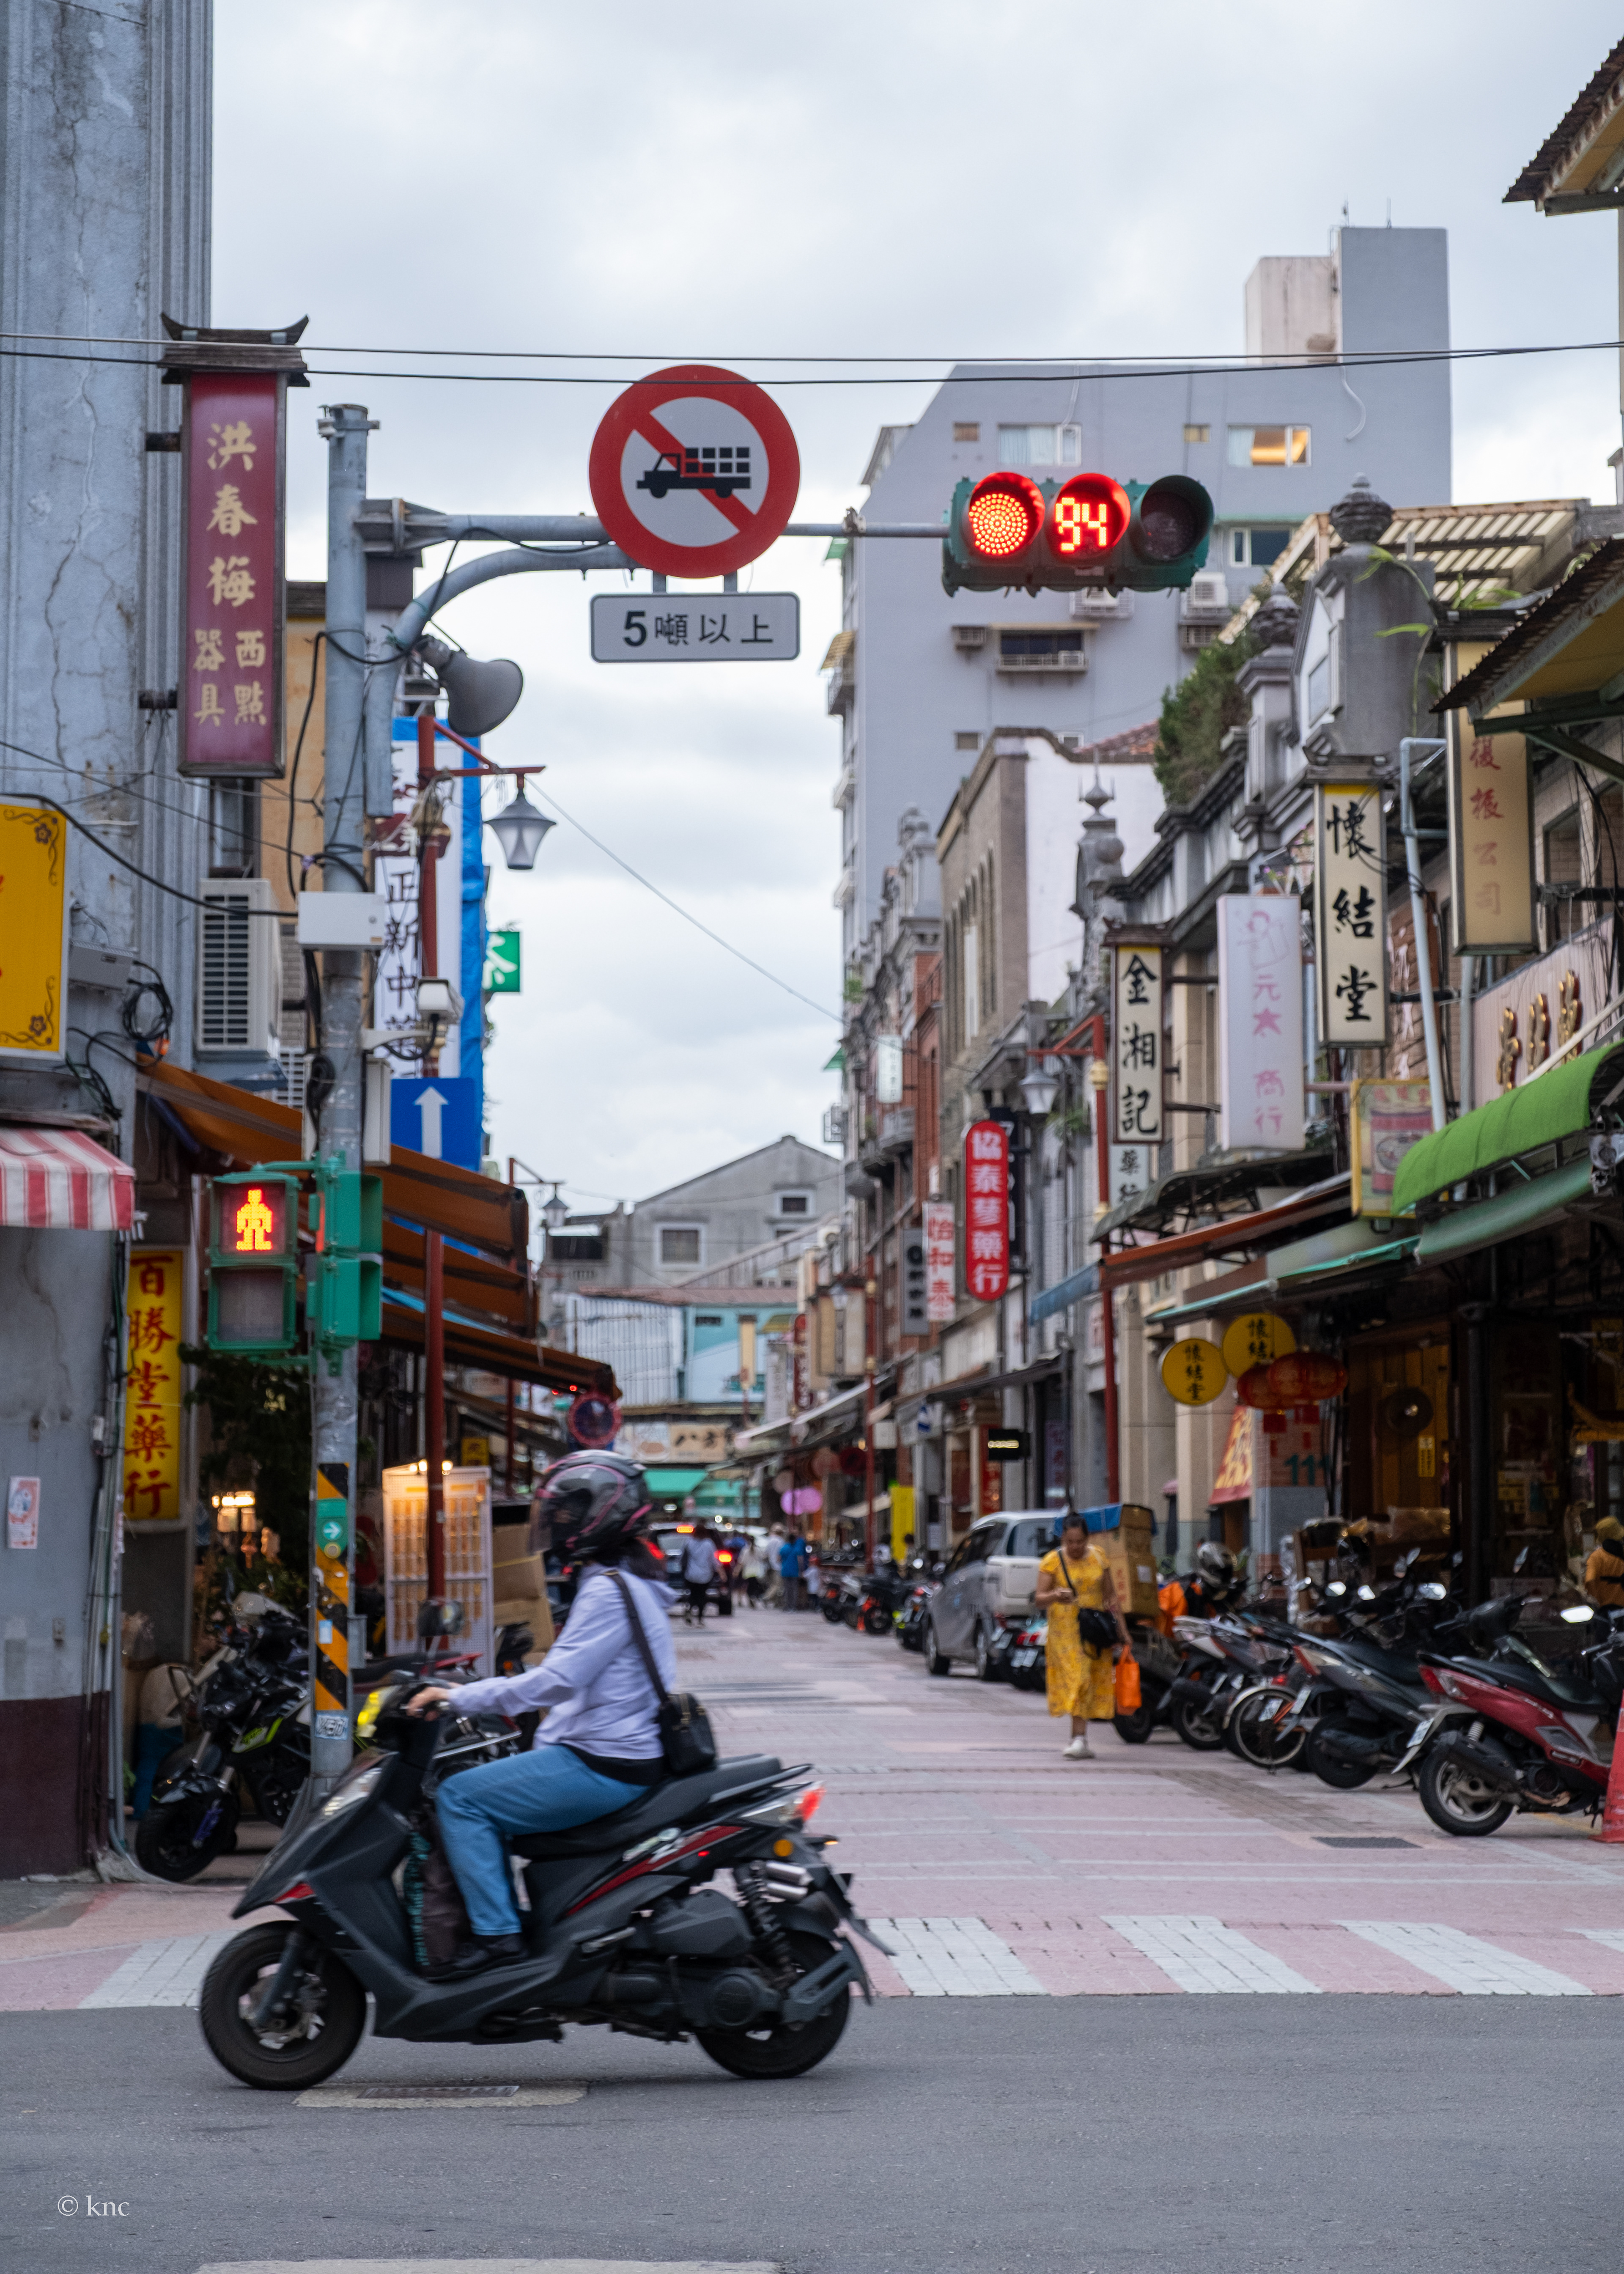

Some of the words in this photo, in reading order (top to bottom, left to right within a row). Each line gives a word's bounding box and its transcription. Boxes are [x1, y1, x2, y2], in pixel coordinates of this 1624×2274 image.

[207, 421, 257, 607] 洪春梅
[1056, 497, 1107, 552] 94
[193, 628, 225, 727] 器具
[234, 630, 267, 726] 西點
[623, 611, 774, 648] 5噸以上
[1326, 800, 1378, 1023] 懷結堂
[1121, 953, 1159, 1136] 金湘記
[125, 1255, 175, 1518] 百勝堂藥行
